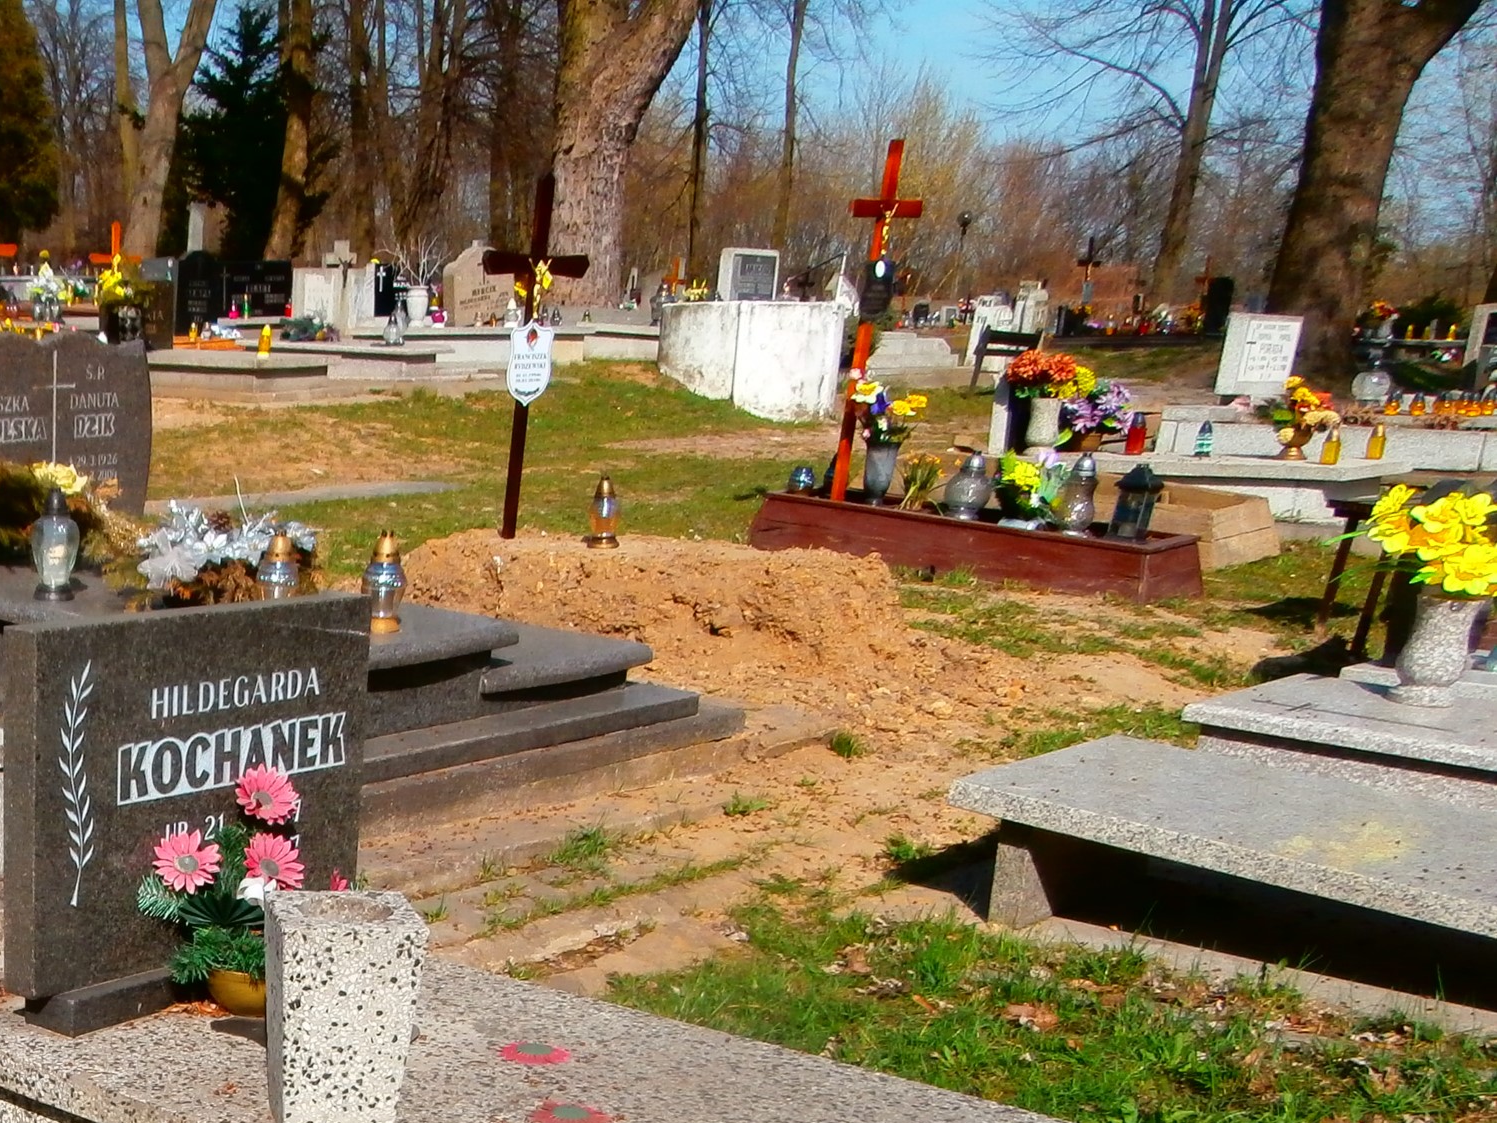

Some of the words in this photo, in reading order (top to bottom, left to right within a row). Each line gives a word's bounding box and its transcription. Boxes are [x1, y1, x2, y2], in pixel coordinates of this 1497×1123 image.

[69, 392, 120, 410] DANUTA
[74, 412, 116, 439] DZIK
[150, 666, 322, 721] HILDEGARDA
[116, 710, 348, 806] KOCHANEK
